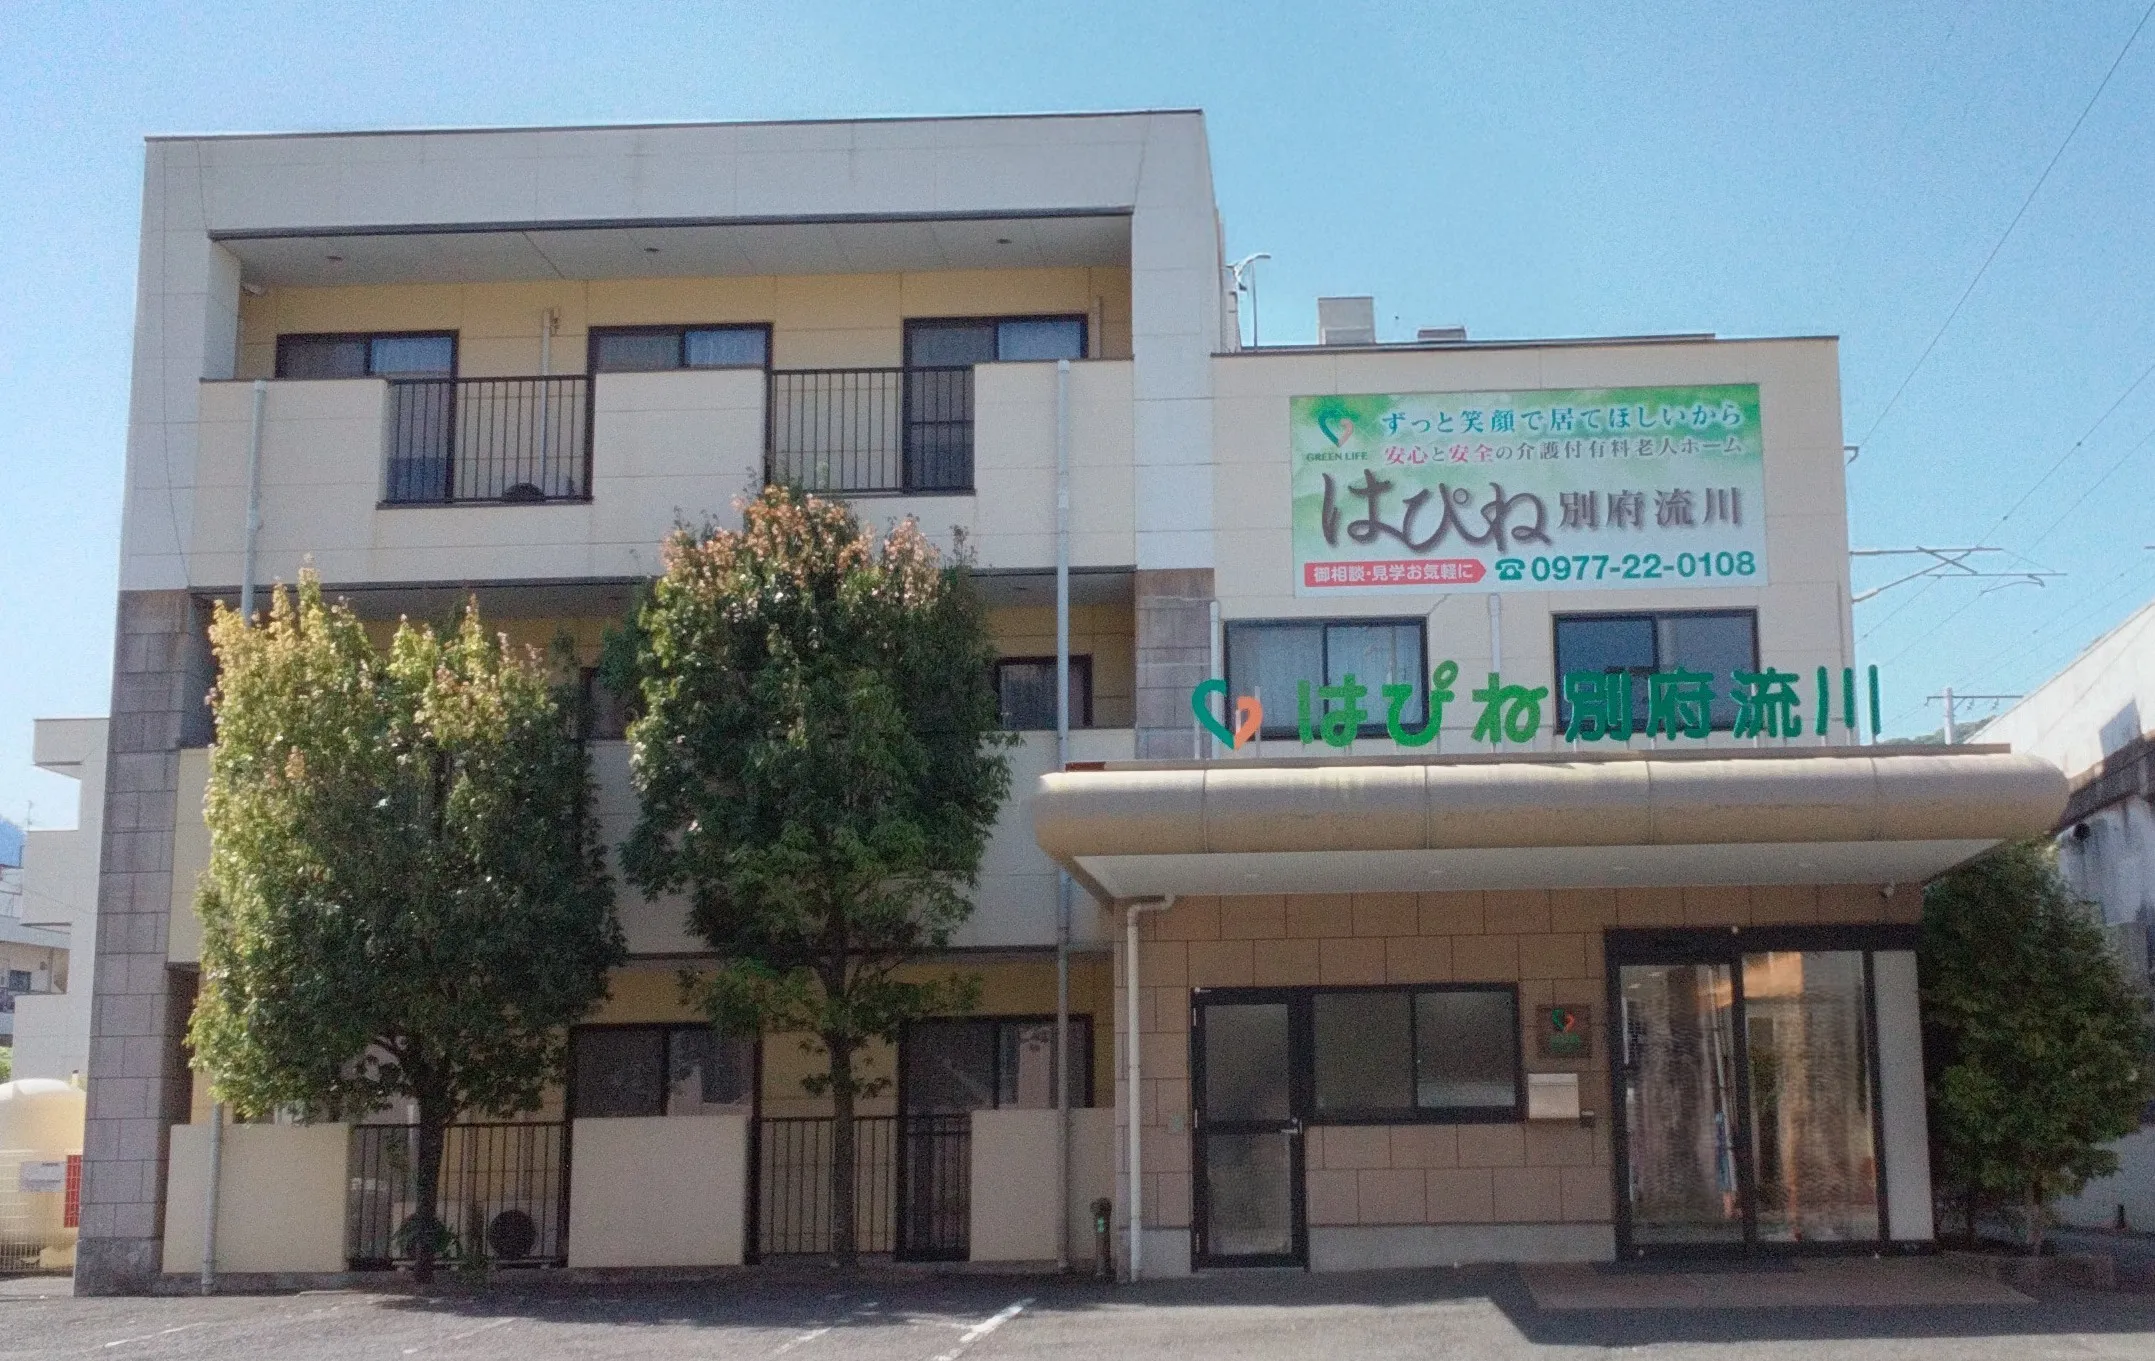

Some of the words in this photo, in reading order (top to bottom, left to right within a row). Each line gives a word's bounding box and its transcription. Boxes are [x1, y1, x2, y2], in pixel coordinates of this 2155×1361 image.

[1382, 403, 1741, 435] ずっと笑顔で居てほしいから
[1306, 452, 1343, 462] GREEN
[1345, 451, 1368, 461] LIFE
[1384, 437, 1742, 465] 安心と安全の介護付有料老人ホーム
[1531, 550, 1756, 582] 0977-22-0108
